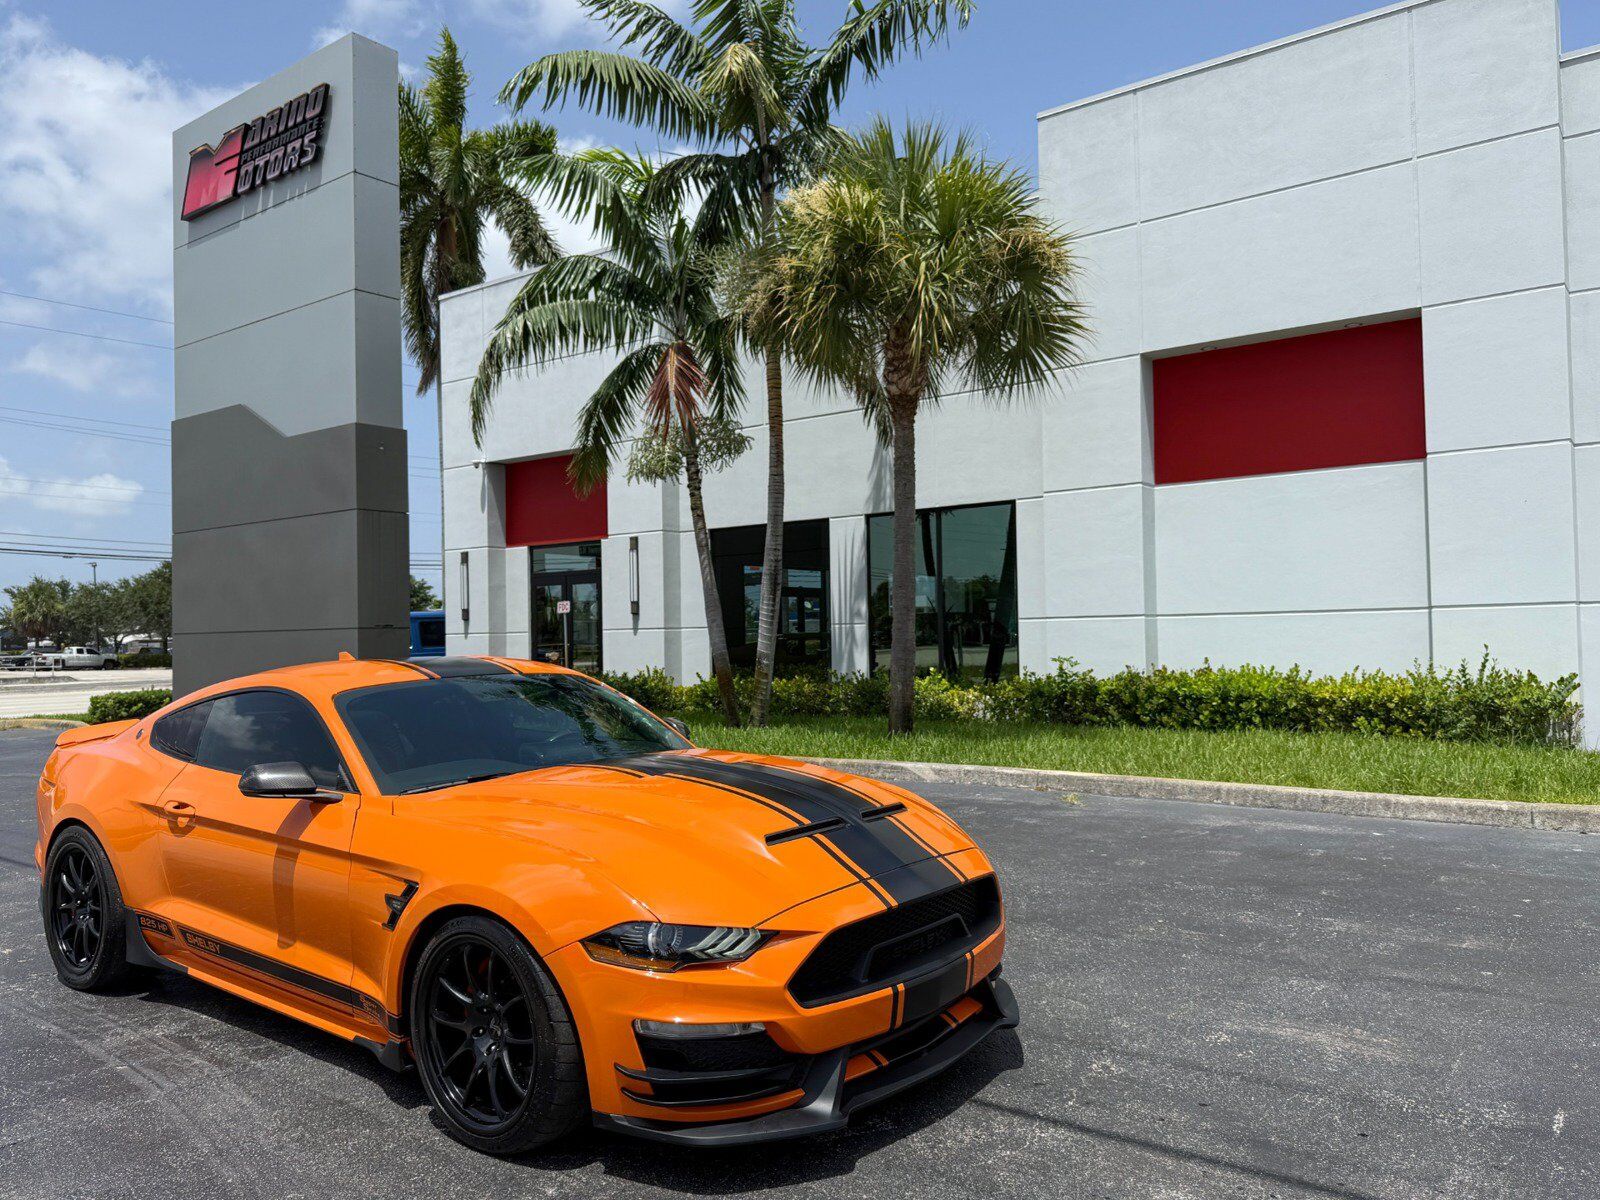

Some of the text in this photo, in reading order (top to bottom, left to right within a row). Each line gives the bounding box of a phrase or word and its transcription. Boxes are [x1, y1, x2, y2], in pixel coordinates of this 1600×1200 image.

[240, 118, 320, 165] PERFORMANCE
[158, 921, 168, 932] HP
[186, 932, 221, 954] SHELBY
